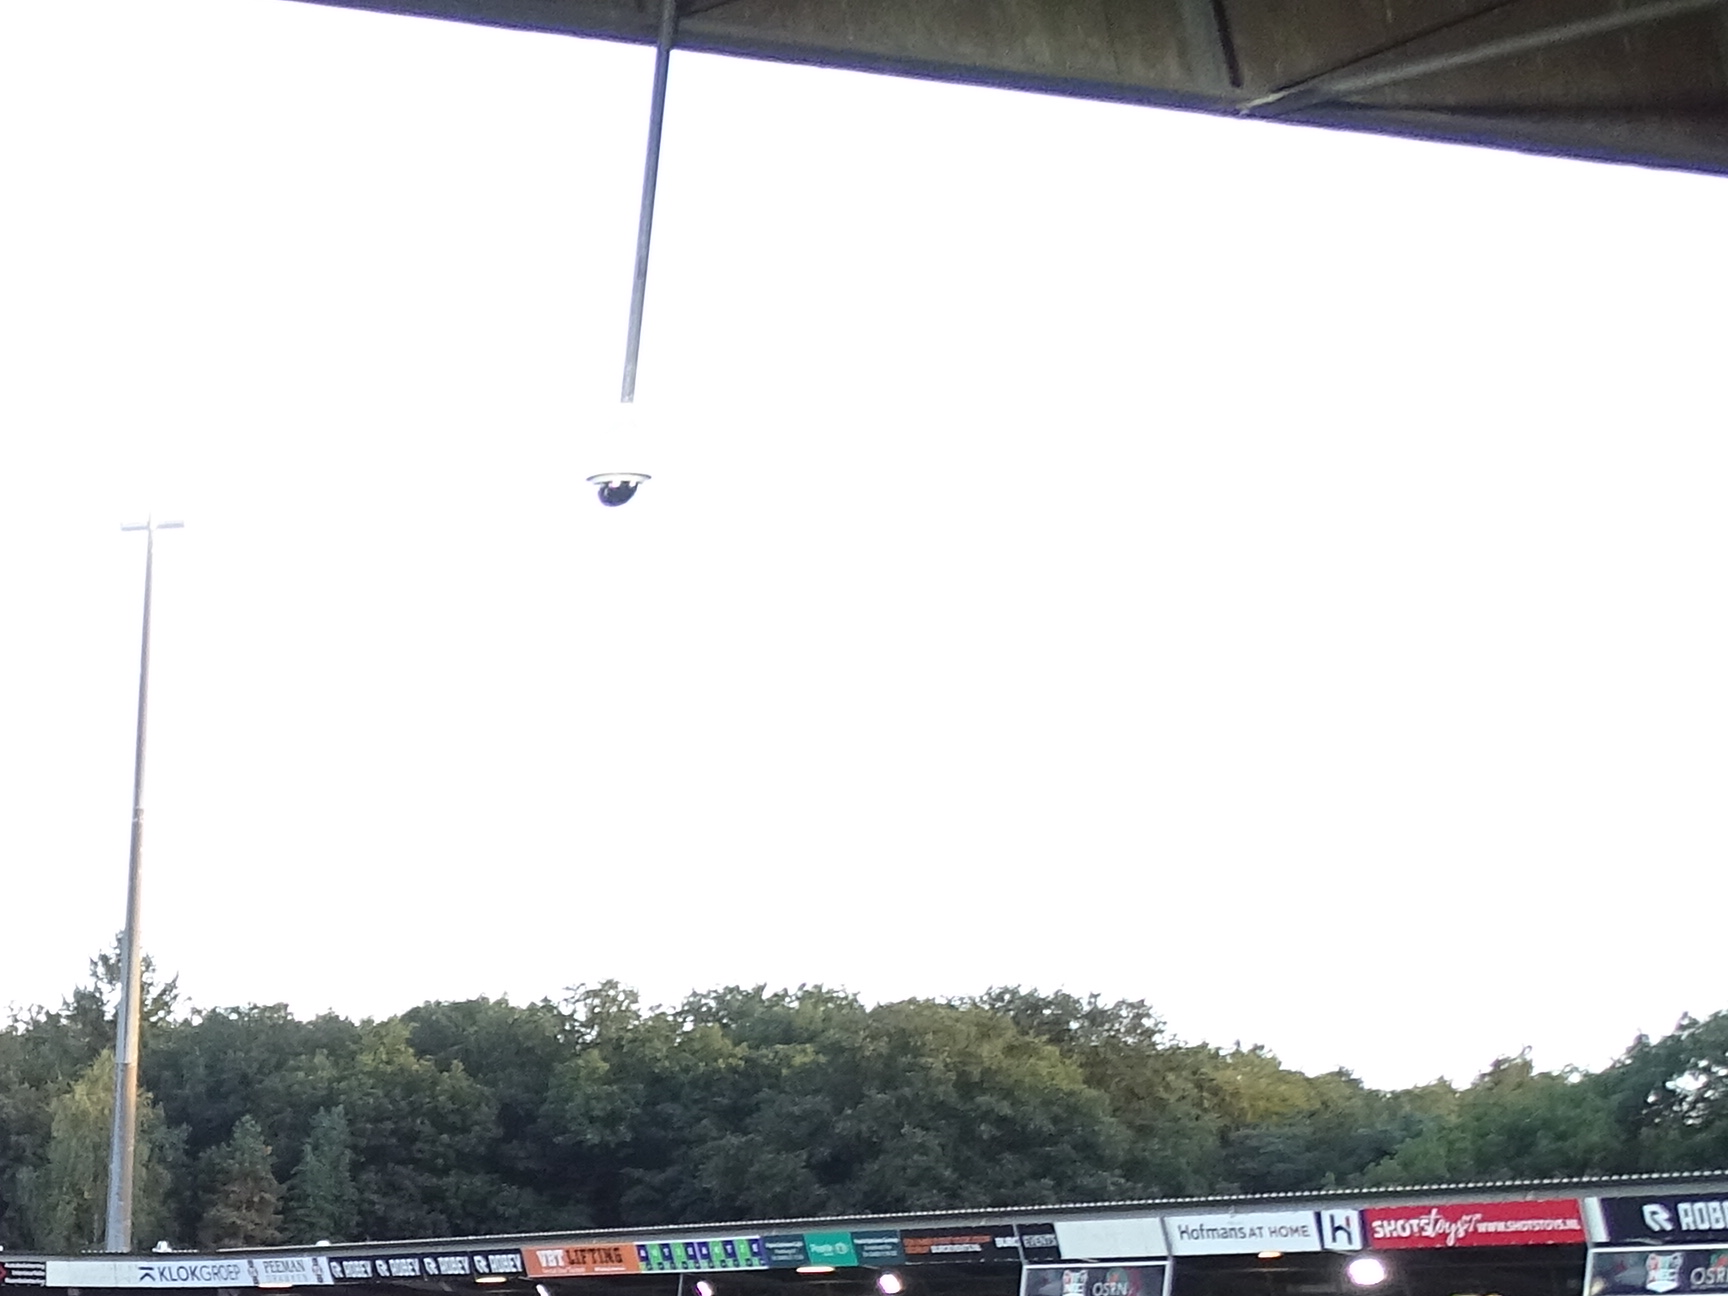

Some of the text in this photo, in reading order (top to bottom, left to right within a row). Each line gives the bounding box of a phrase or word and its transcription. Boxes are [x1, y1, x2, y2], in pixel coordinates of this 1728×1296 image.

[1178, 1224, 1311, 1242] Hofmans AT HOME
[565, 1248, 624, 1266] LIFTING
[157, 1263, 241, 1282] KLOKGROEP
